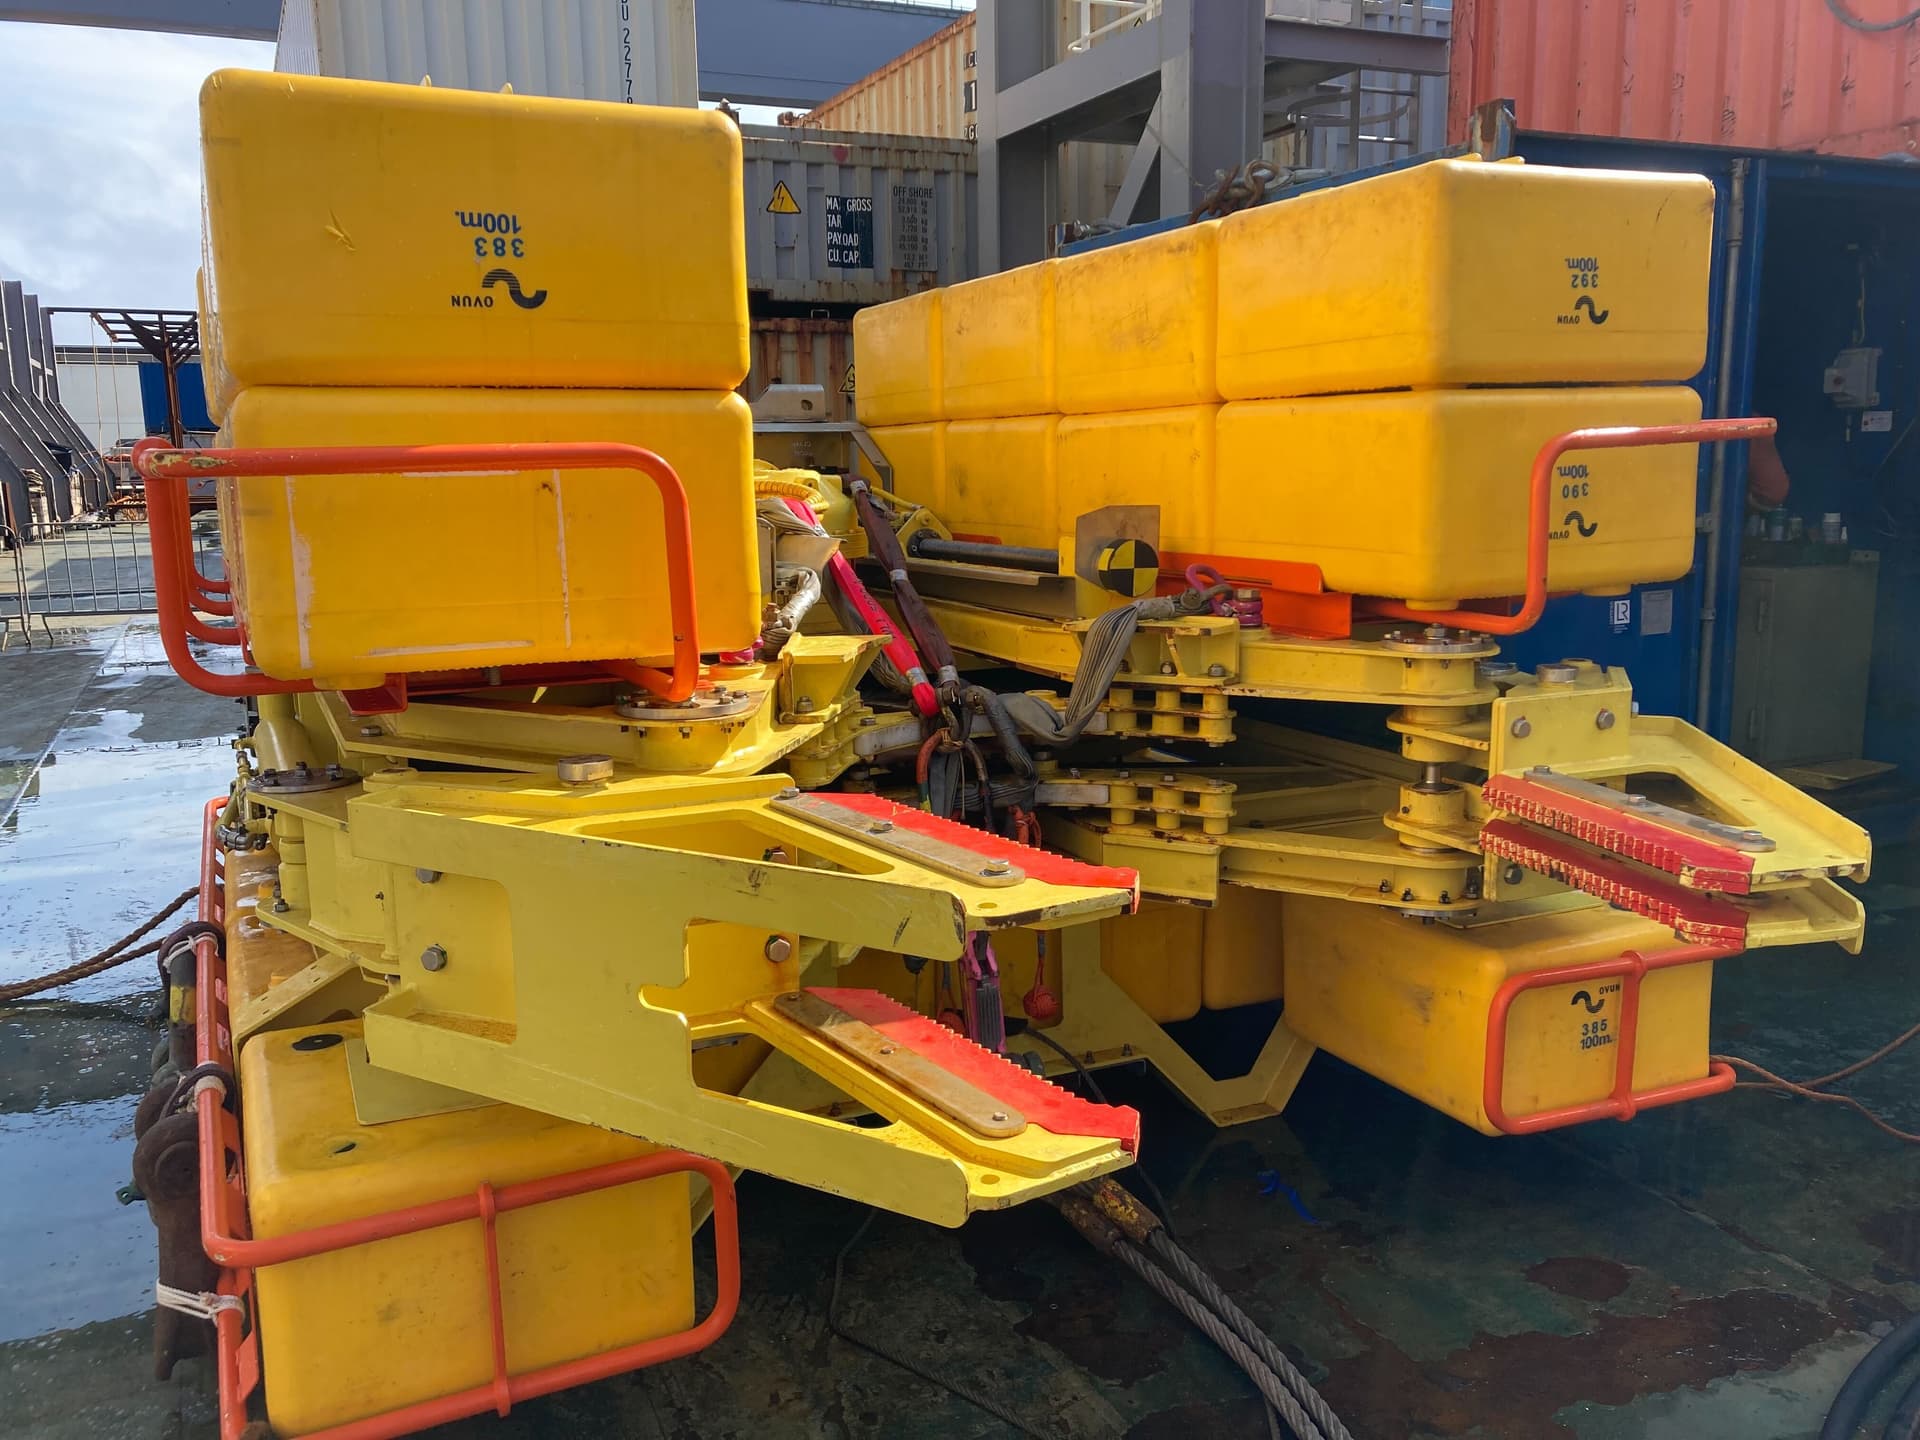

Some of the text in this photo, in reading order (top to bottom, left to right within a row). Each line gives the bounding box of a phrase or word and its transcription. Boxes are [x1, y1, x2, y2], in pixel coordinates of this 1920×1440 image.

[893, 186, 933, 199] OFF SHORE
[826, 197, 872, 212] MA GROSS
[455, 211, 522, 234] 100m.
[827, 214, 842, 229] TAR
[827, 231, 859, 247] PAYOAD
[474, 237, 524, 258] 383
[1565, 257, 1599, 272] 100m.
[1571, 273, 1599, 288] 392
[451, 295, 494, 308] OVUN
[1557, 314, 1580, 325] OVUN
[1557, 464, 1589, 478] 100m.
[1562, 483, 1589, 498] 390
[1599, 984, 1620, 995] OVUN
[1580, 1034, 1612, 1050] 100m.
